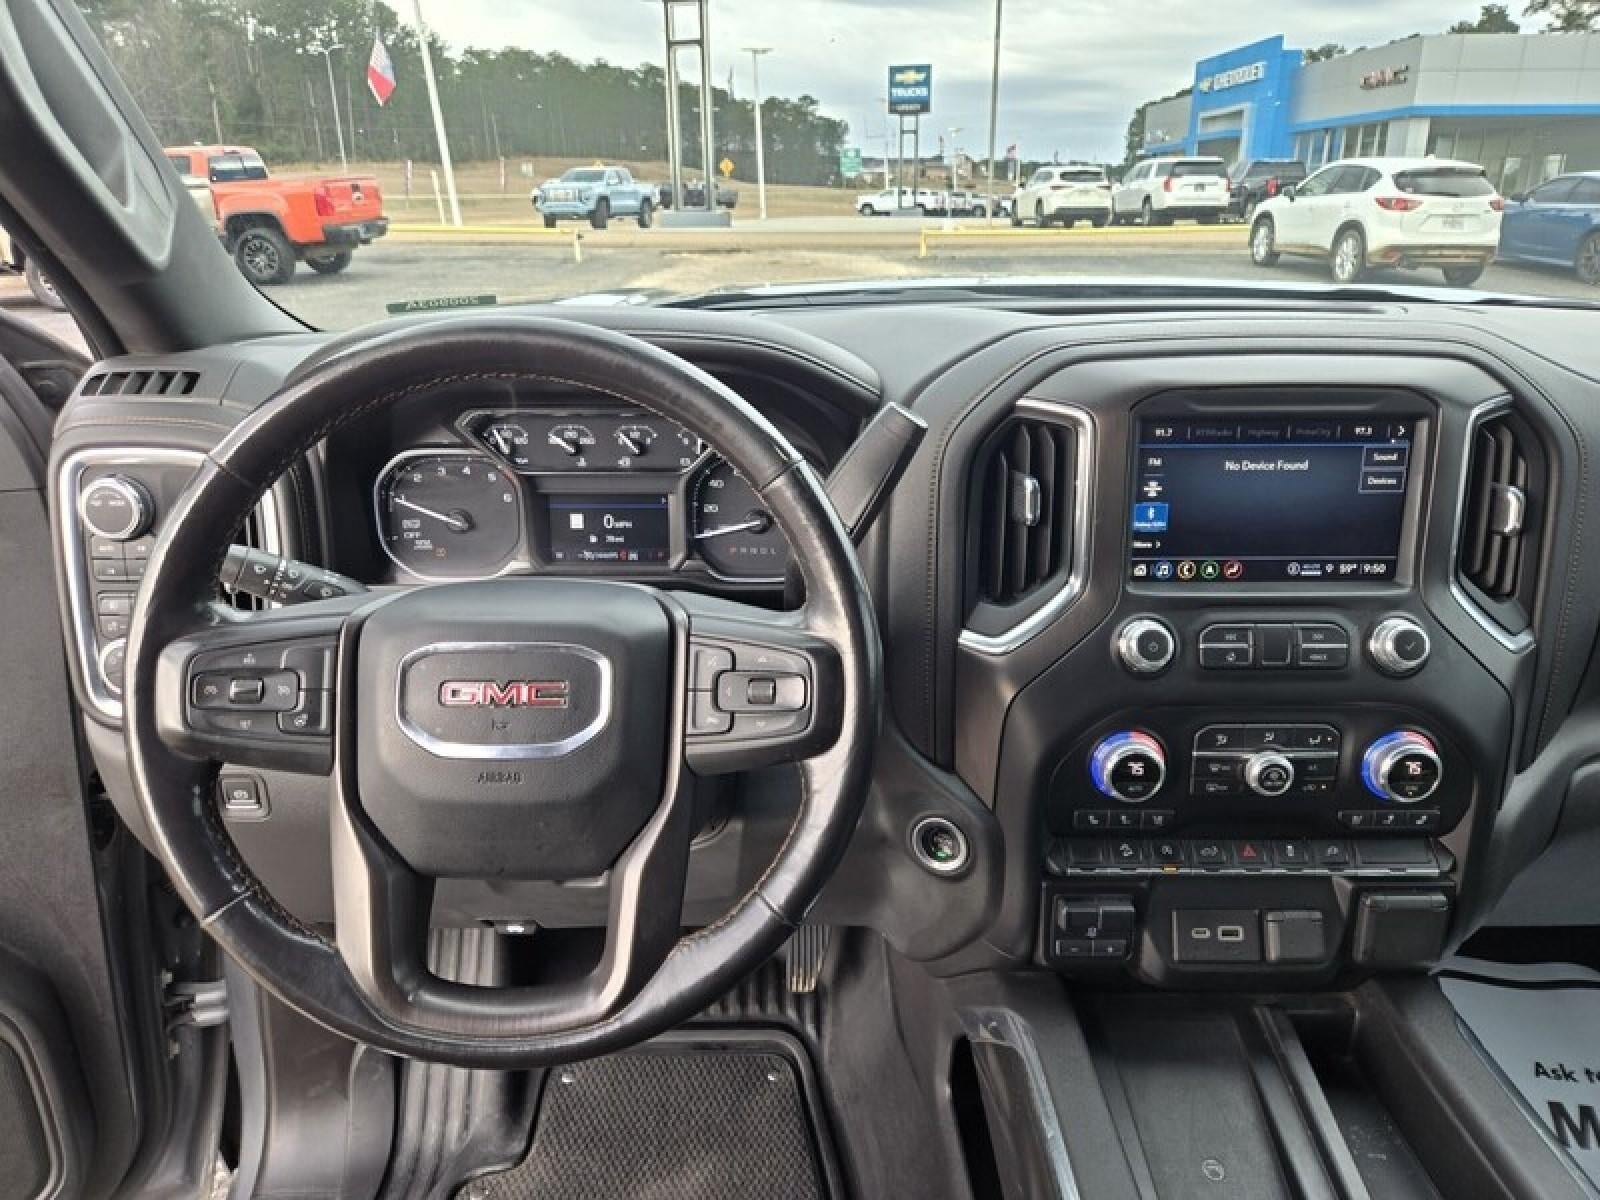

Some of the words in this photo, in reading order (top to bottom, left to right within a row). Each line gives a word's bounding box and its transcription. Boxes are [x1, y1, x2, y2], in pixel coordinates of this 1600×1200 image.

[1359, 64, 1408, 89] GMC
[892, 87, 928, 97] TRUCKS
[1224, 460, 1240, 471] No
[1242, 460, 1275, 471] Device
[1278, 460, 1309, 471] Found
[603, 513, 613, 529] 0
[438, 680, 568, 708] GMC
[478, 771, 521, 783] AIRBAG
[1535, 1061, 1579, 1083] Ask
